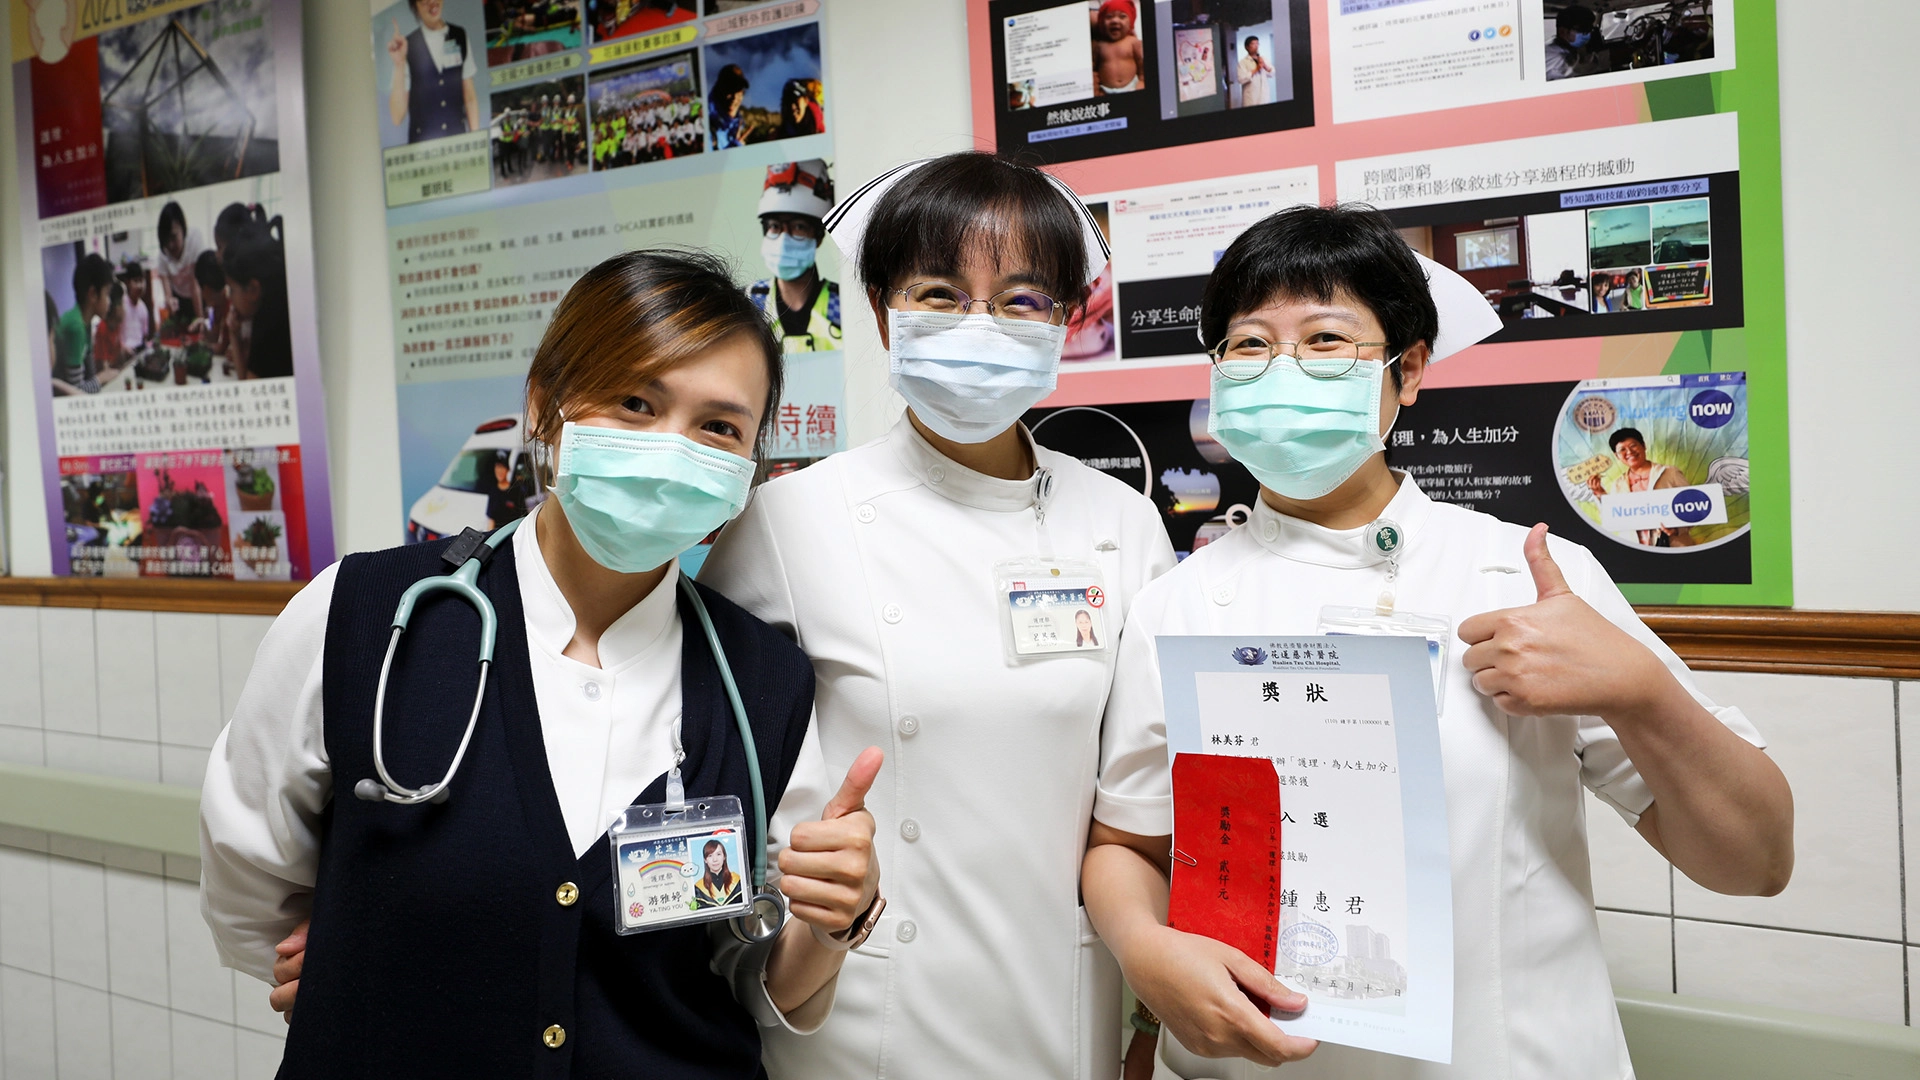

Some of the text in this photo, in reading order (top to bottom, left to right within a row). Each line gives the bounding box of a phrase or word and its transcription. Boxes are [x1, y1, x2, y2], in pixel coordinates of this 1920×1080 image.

[1046, 103, 1110, 126] 然後說故事
[1363, 163, 1431, 186] 跨國詞窮
[1364, 157, 1635, 201] 以音樂和影像敘述分享過程的撼動
[1563, 181, 1703, 206] 將知識和技能做跨國專業分享
[1620, 404, 1687, 422] Nursing
[1691, 402, 1733, 417] now
[1612, 499, 1710, 518] Nursing now
[1271, 650, 1339, 660] 花蓮慈濟醫院
[1211, 734, 1260, 747] 林美芬 君
[651, 872, 673, 882] 護理部
[1218, 860, 1230, 900] 貳仟元
[648, 891, 682, 905] 游雅婷
[649, 903, 683, 914] YA-TING YOU
